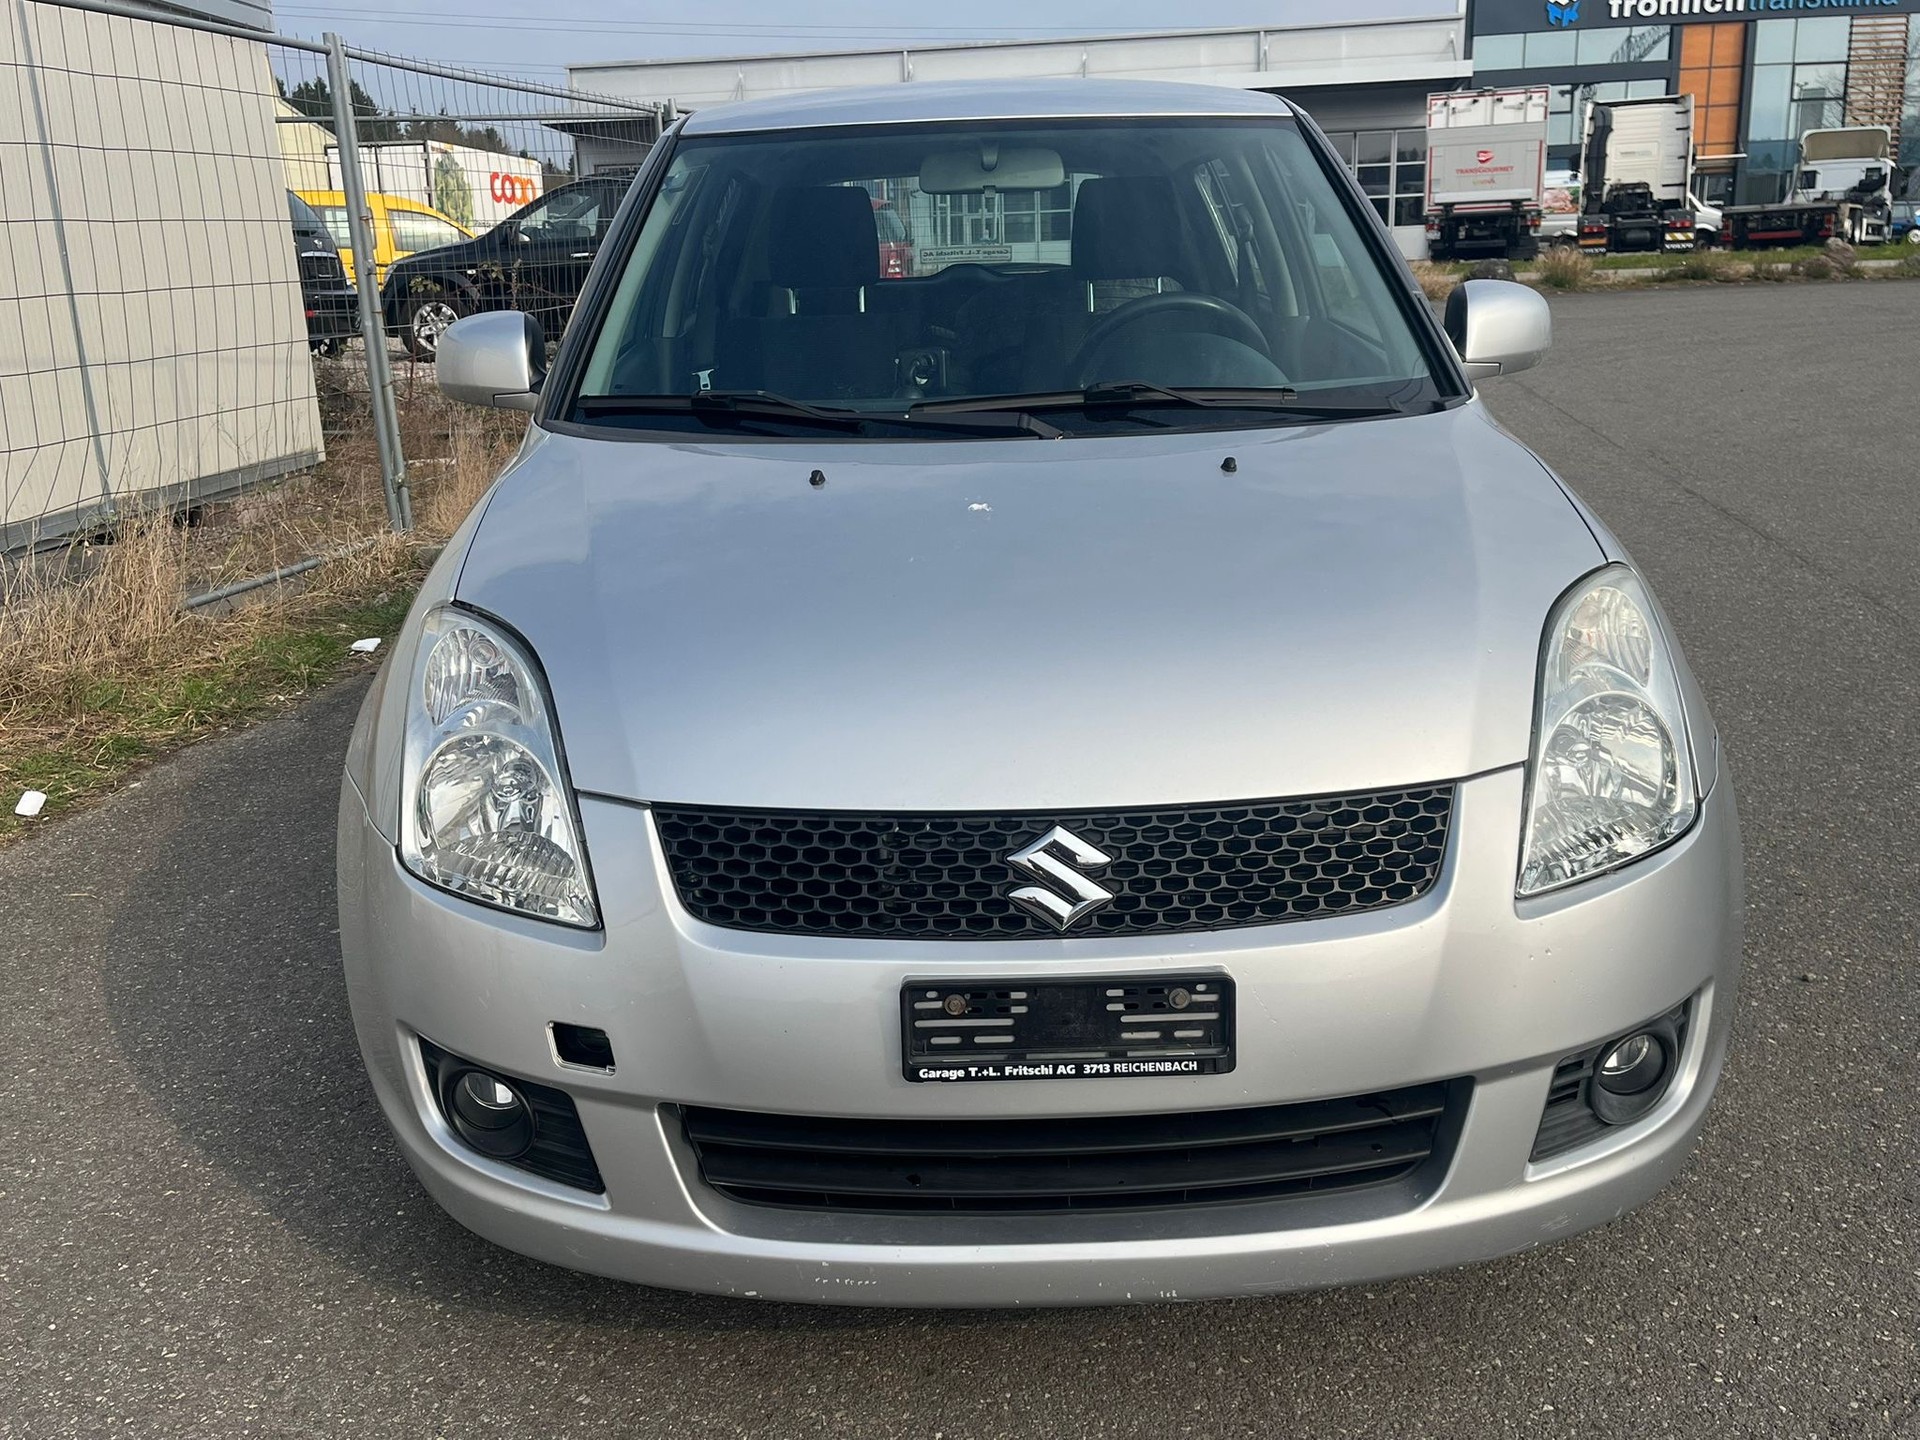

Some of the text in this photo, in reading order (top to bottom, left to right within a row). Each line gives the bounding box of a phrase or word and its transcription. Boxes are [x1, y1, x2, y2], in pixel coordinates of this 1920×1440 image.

[918, 1060, 1198, 1080] Garage T.+L. Fritschi AG 3713 REICHENBACH
